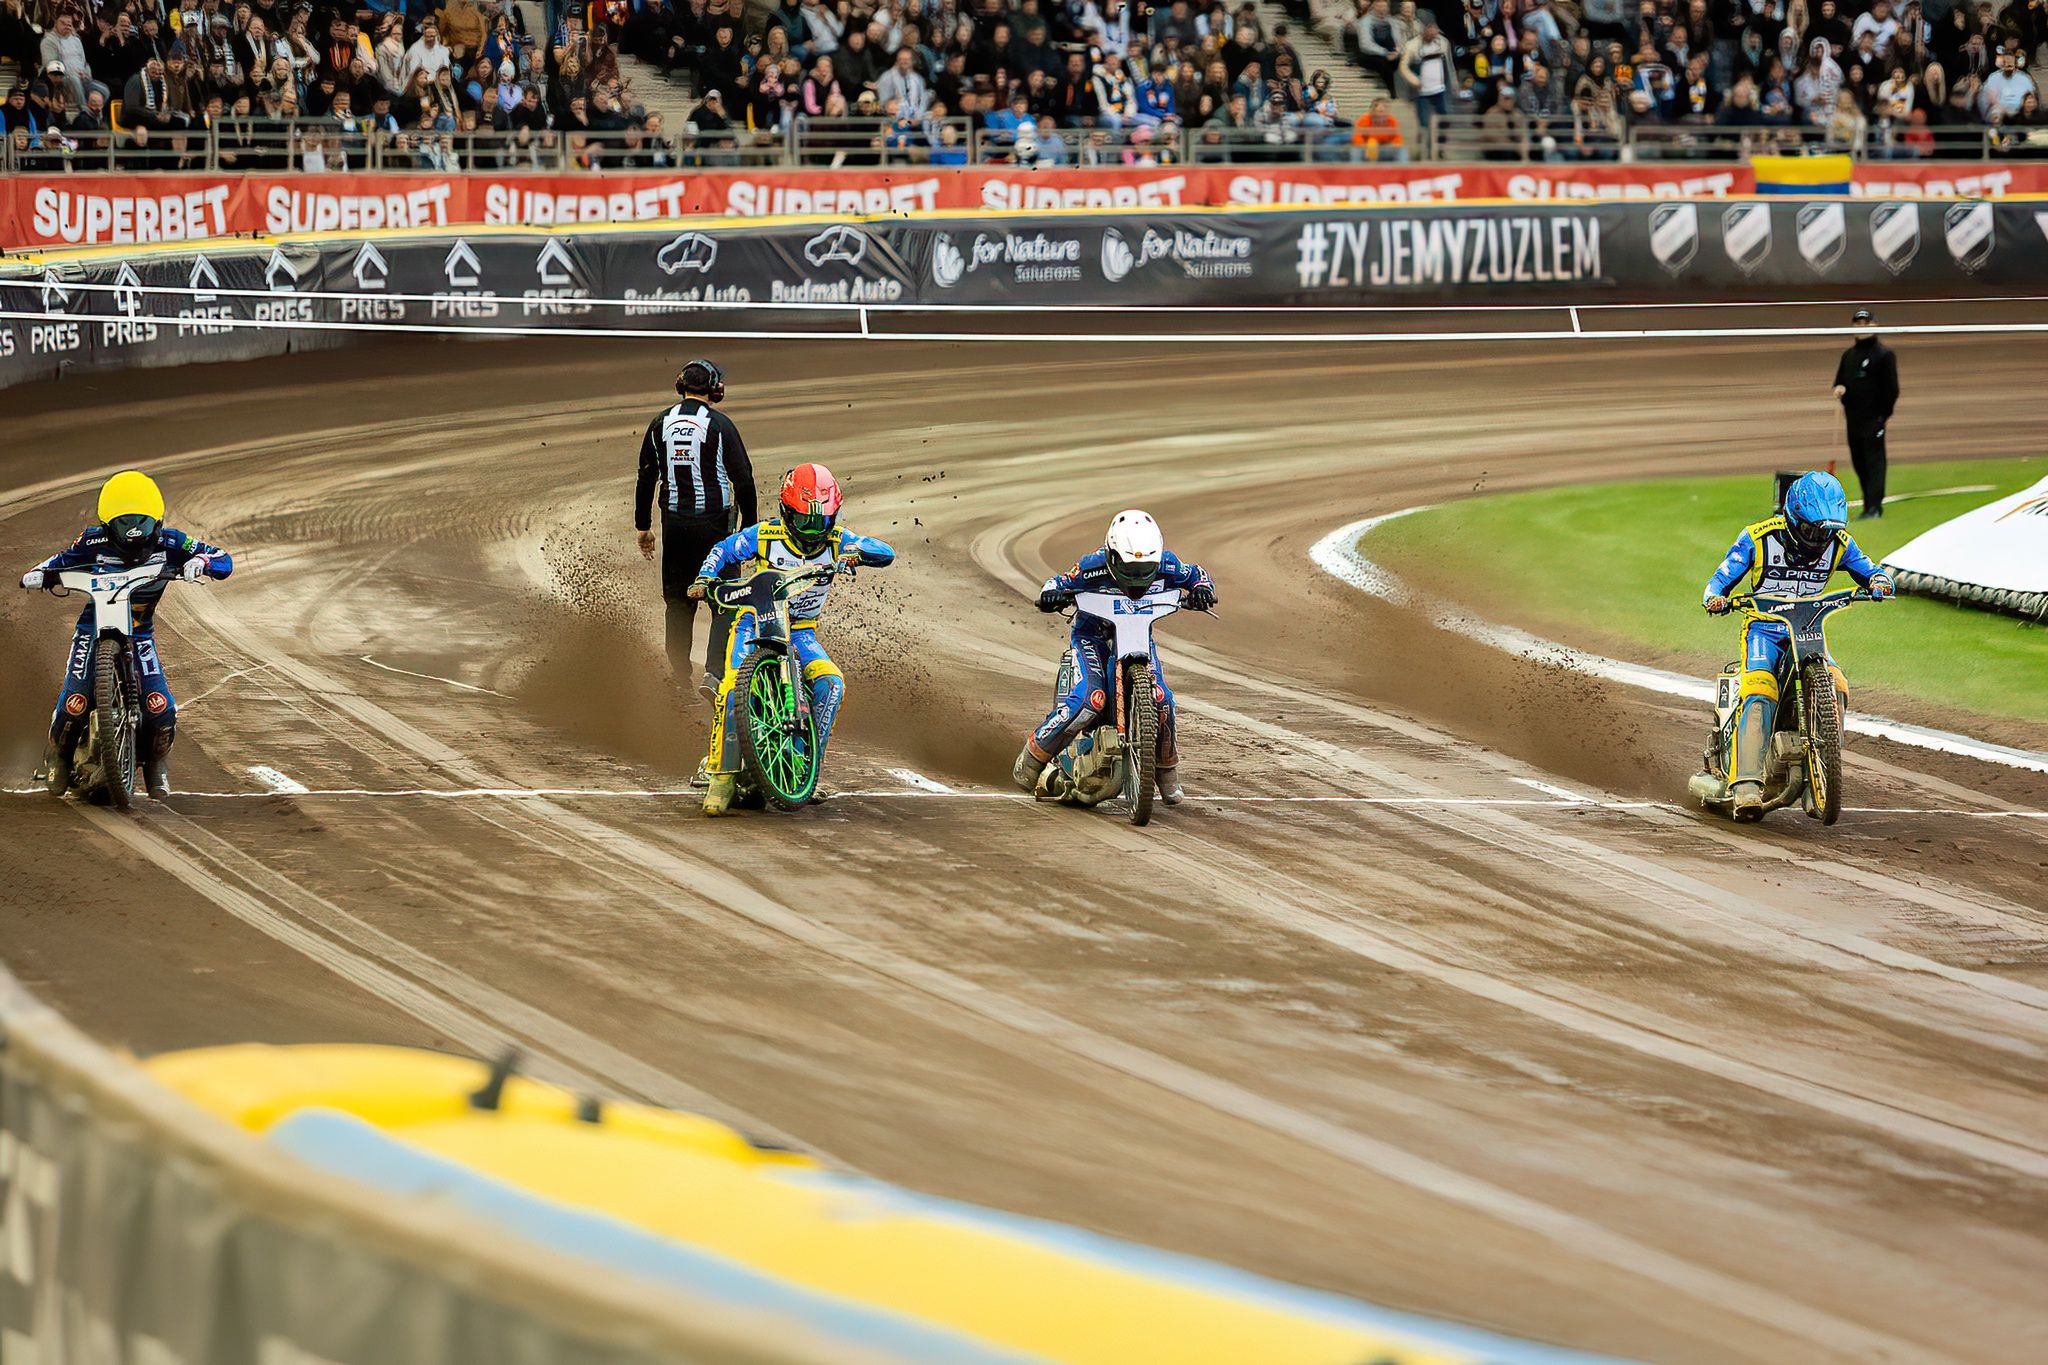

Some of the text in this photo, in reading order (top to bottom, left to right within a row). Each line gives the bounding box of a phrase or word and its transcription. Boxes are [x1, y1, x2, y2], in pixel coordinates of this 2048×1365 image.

[33, 184, 229, 244] SUPERBET
[266, 185, 450, 234] SUPERBET
[967, 233, 1081, 272] for Nature
[1134, 228, 1250, 267] for Nature
[431, 290, 499, 319] PRES
[522, 288, 594, 316] PRES
[772, 276, 902, 302] Budmat Auto
[178, 305, 234, 337] PRES
[255, 298, 315, 330] PRES
[340, 297, 405, 321] PRES
[31, 322, 80, 354] PRES
[103, 315, 158, 347] PRES
[671, 427, 696, 437] PGE
[724, 586, 752, 603] LAVOR
